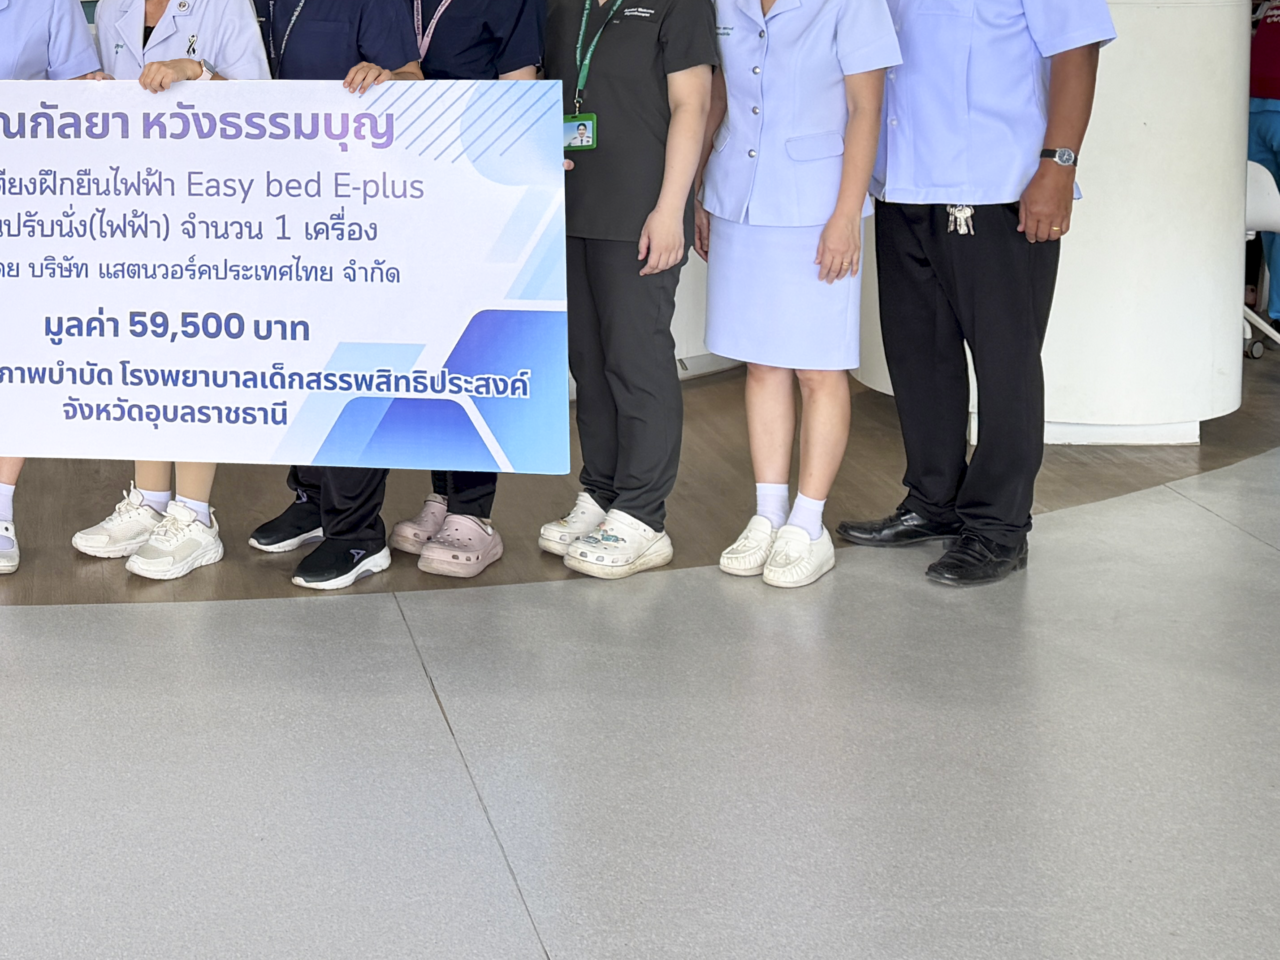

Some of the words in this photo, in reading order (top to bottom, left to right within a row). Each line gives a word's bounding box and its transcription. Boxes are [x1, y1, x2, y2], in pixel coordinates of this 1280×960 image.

[142, 101, 396, 152] หวังธรรมบุญ
[187, 171, 255, 204] Easy
[266, 171, 322, 198] bed
[334, 172, 425, 205] E-plus
[180, 212, 264, 241] จำนวน
[275, 214, 291, 240] 1
[304, 206, 378, 241] เครื่อง
[28, 254, 89, 279] บริษัท
[98, 254, 334, 282] แสตนวอร์คประเทศไทย
[342, 258, 401, 284] จำกัด
[44, 307, 120, 346] มูลค่า
[129, 311, 245, 343] 59,500
[253, 319, 310, 342] บาท
[119, 361, 530, 397] โรงพยาบาลเด็กสรรพสิทธิประสงค์
[62, 396, 288, 429] จังหวัดอุบลราชธานี
